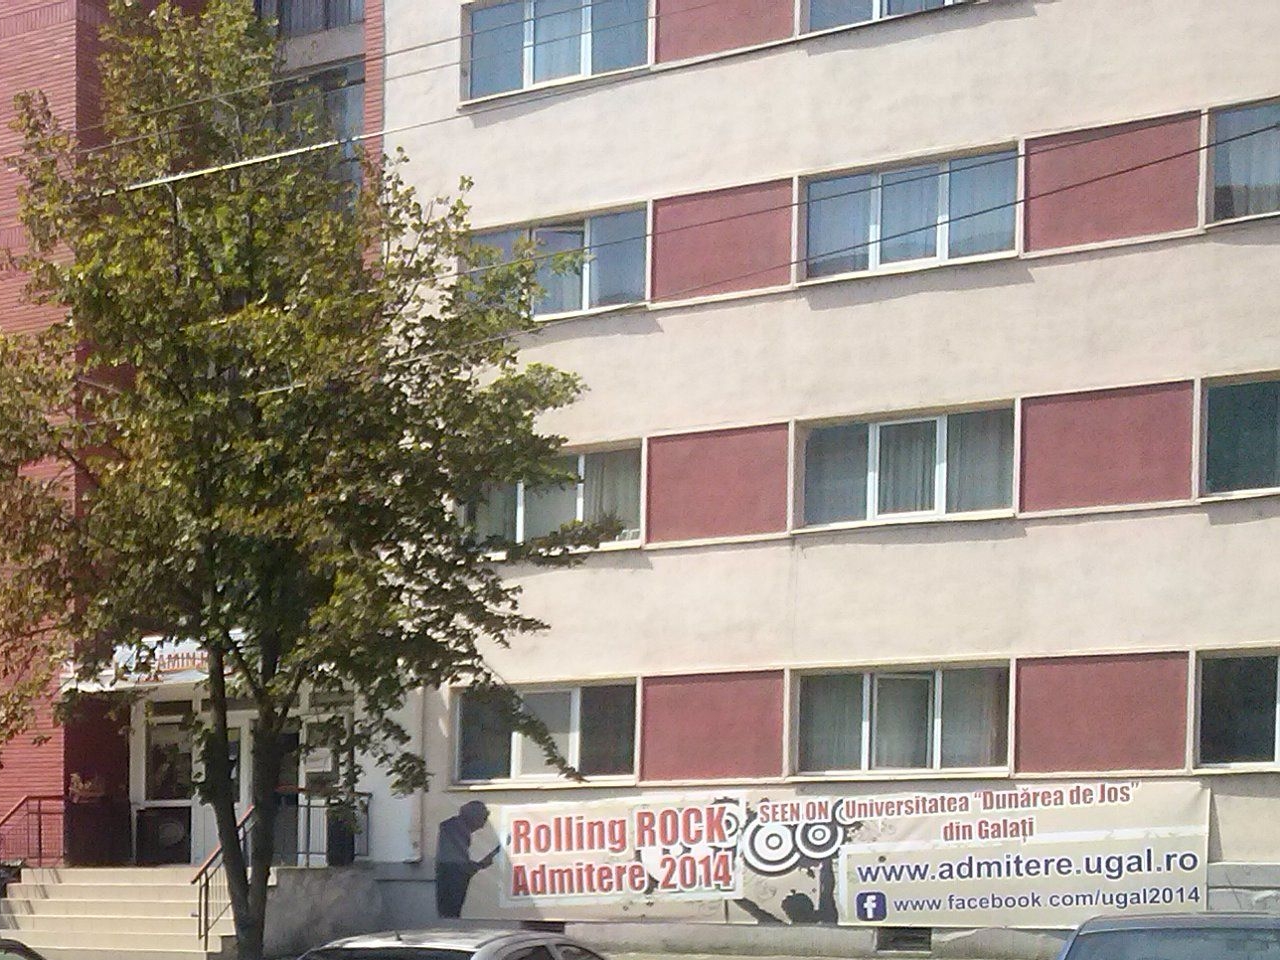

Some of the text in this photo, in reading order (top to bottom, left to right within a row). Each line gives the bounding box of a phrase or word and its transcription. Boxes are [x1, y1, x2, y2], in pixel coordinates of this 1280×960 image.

[759, 801, 829, 823] SEEN ON
[845, 795, 969, 819] Universitatea
[1069, 783, 1094, 805] de
[512, 806, 727, 855] Rolling ROCK
[943, 816, 1034, 843] din Galați
[512, 854, 732, 896] Admitere 2014
[857, 848, 1198, 883] www.admitere.ugal.ro
